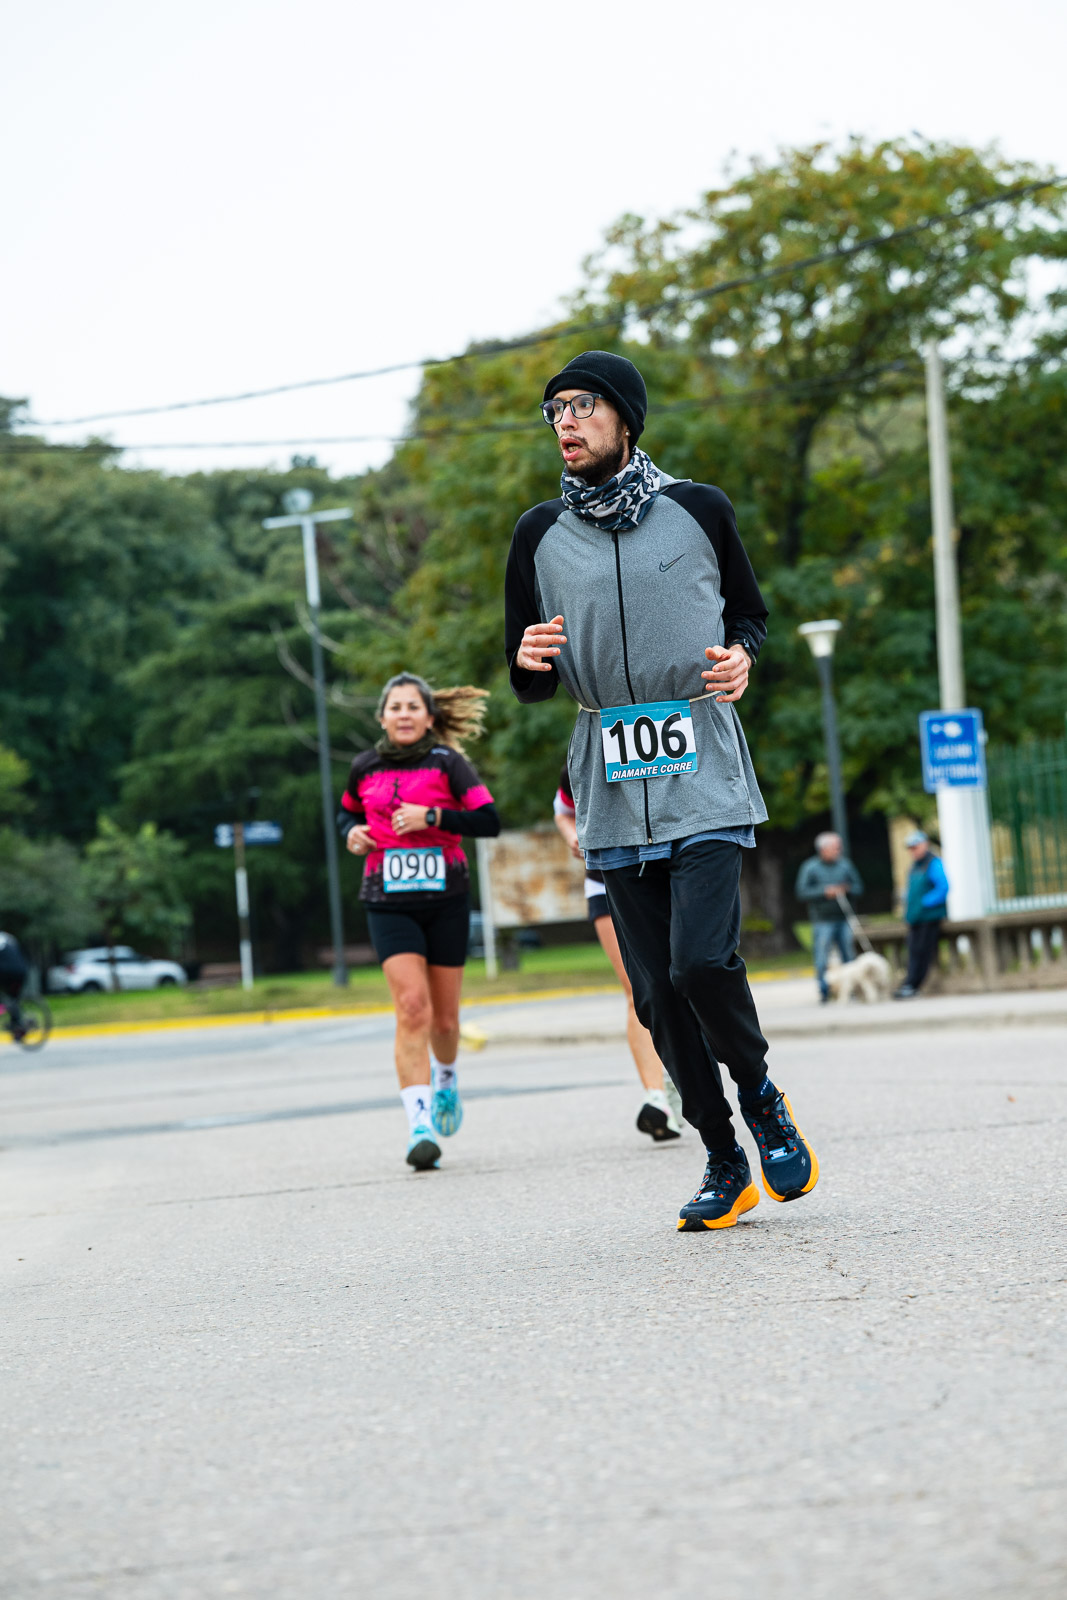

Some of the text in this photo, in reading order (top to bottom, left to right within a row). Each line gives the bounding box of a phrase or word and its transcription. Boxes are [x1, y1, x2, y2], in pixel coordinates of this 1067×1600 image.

[609, 712, 687, 765] 106
[611, 762, 692, 779] DIAMANTE CORRE
[390, 853, 437, 880] 090
